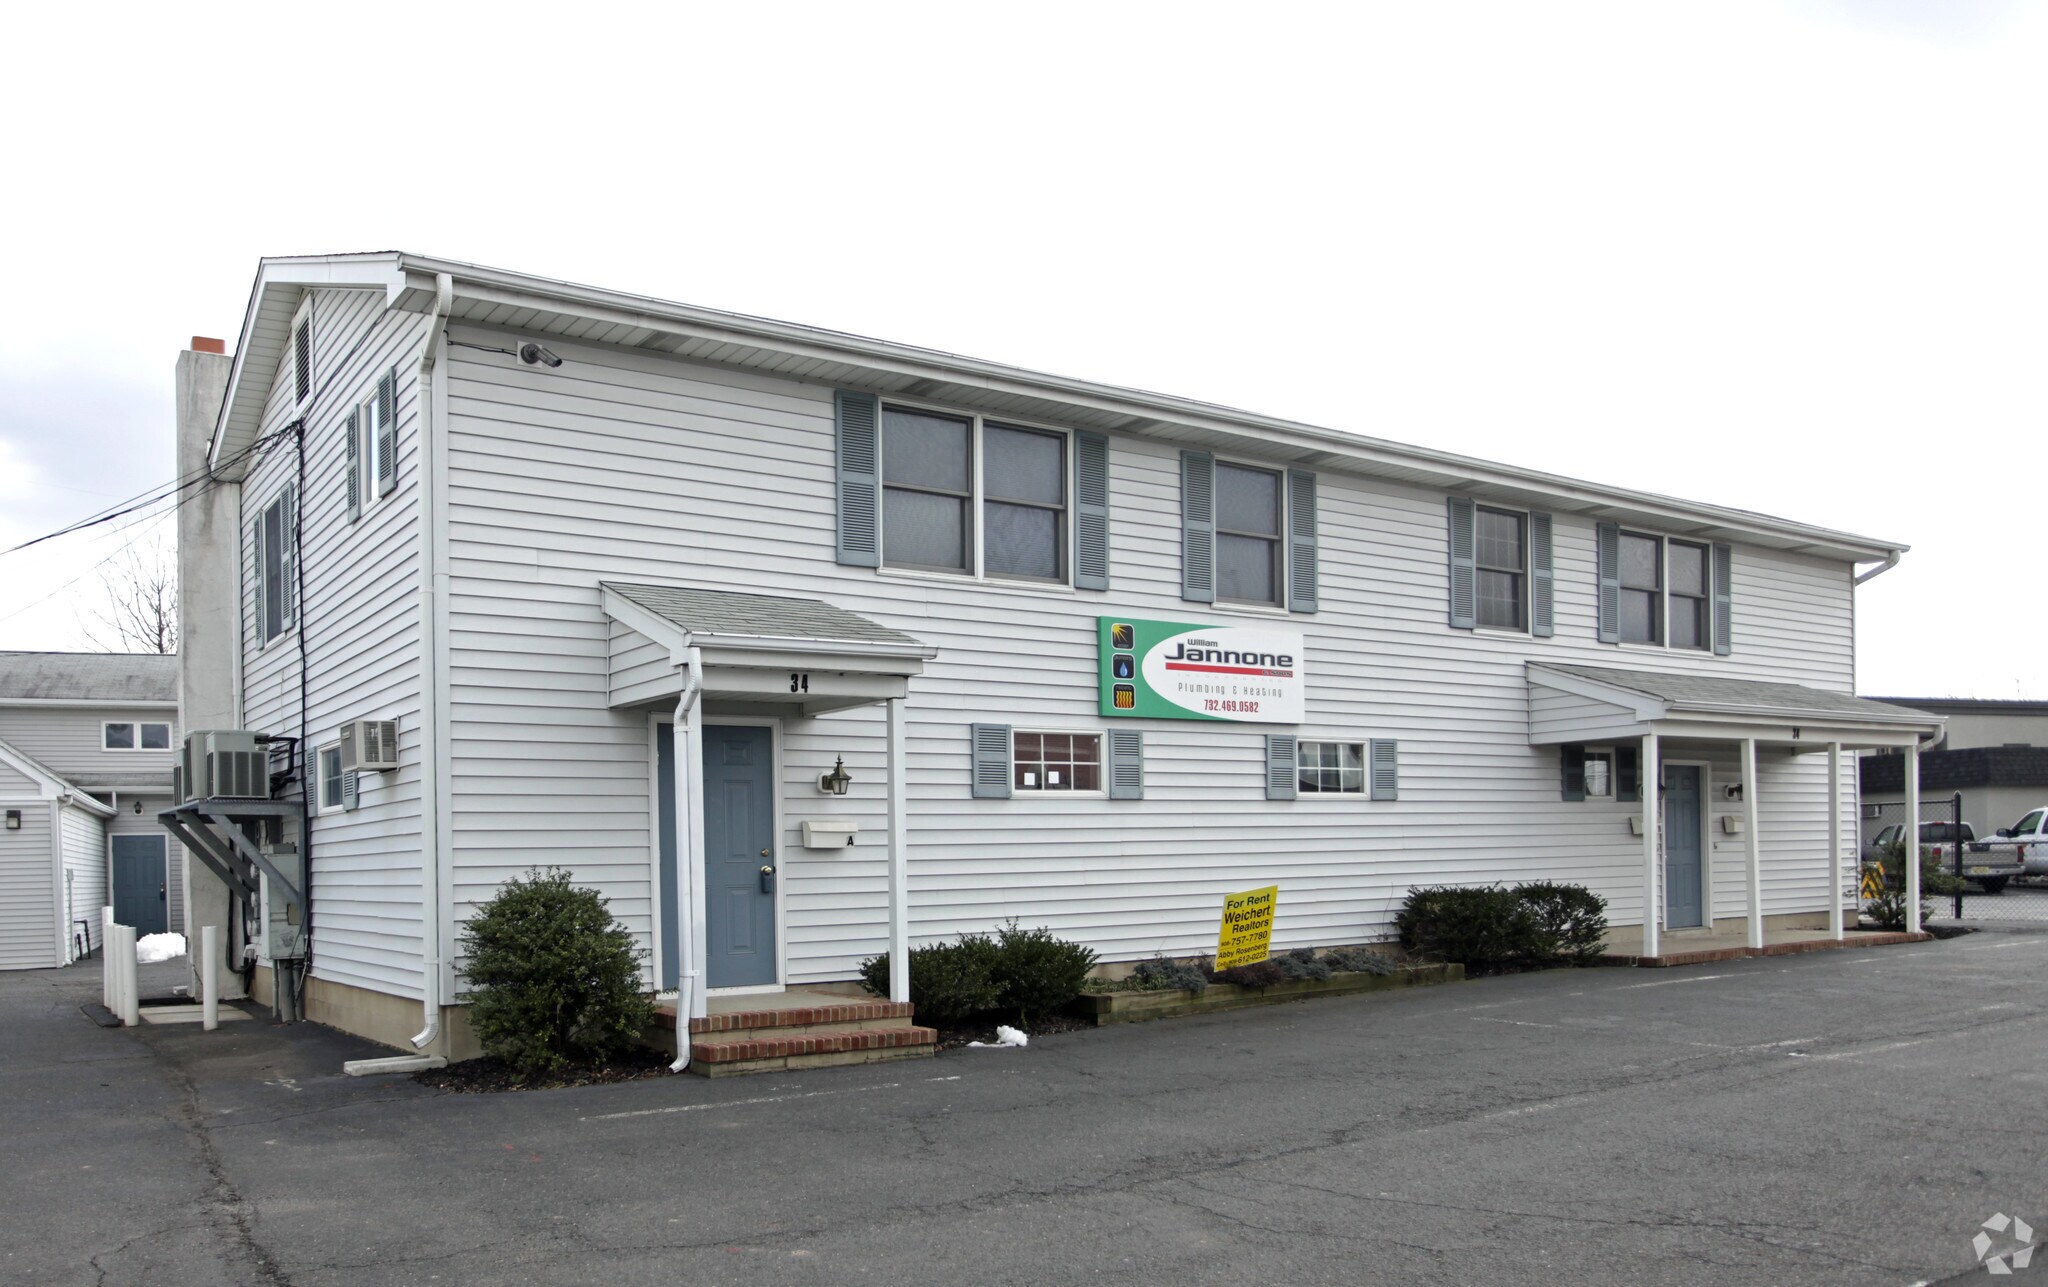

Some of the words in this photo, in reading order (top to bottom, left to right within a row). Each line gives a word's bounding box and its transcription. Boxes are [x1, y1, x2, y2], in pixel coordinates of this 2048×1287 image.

[1187, 638, 1218, 647] William
[1164, 643, 1293, 667] Jannone
[790, 673, 809, 693] 34
[1178, 682, 1226, 695] Plumbing
[1232, 686, 1238, 695] &
[1243, 687, 1282, 698] Heating
[1204, 699, 1259, 713] 732.469.0582
[847, 835, 854, 846] A
[1227, 900, 1244, 910] For
[1247, 893, 1270, 906] Rent
[1225, 905, 1270, 924] Weichert
[1231, 918, 1269, 934] Realtors
[1218, 951, 1234, 959] Abby
[1235, 942, 1267, 956] Rosenberg
